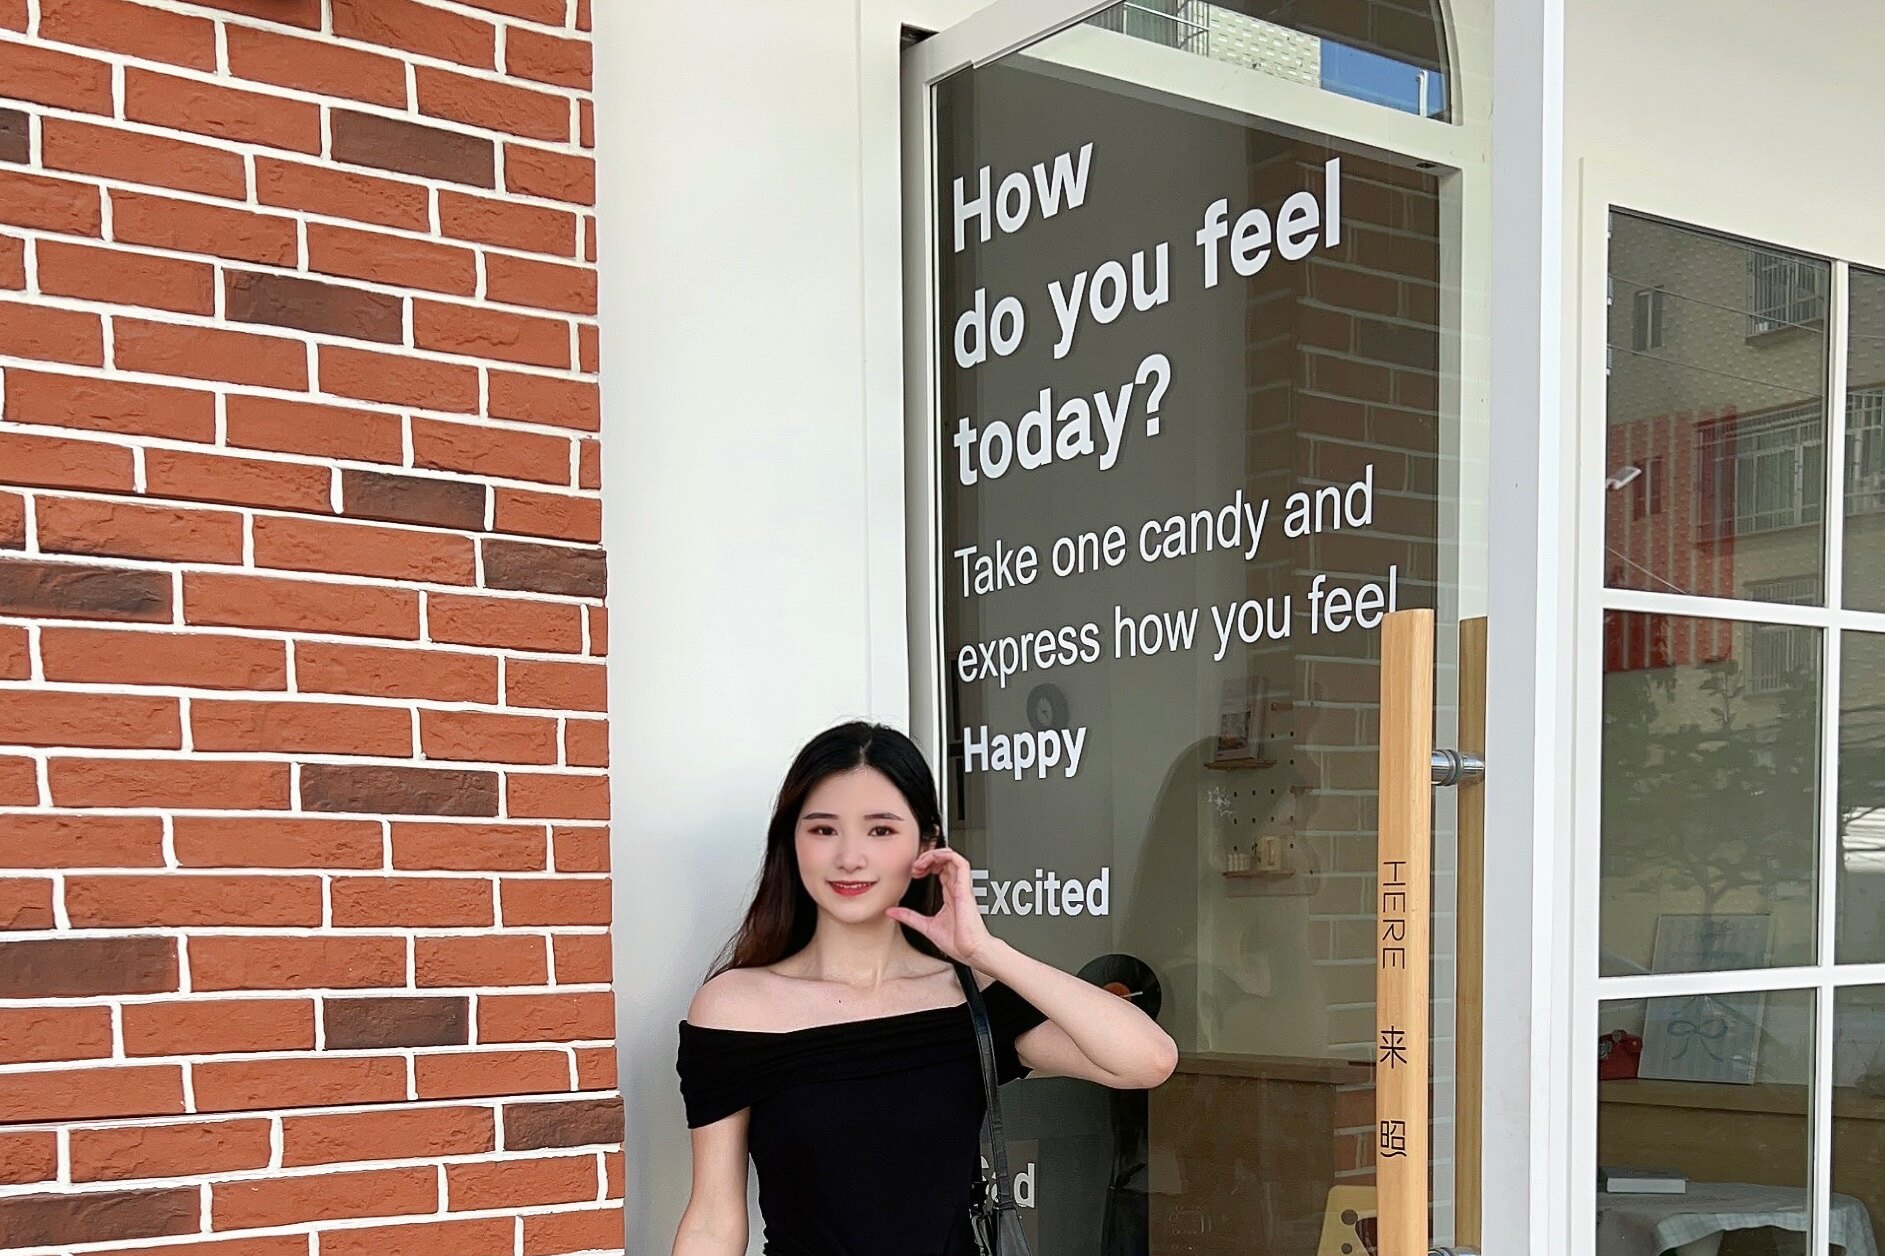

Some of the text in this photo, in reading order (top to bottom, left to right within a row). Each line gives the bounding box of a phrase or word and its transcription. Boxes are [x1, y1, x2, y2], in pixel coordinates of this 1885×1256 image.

[953, 142, 1093, 253] How
[954, 157, 1341, 368] do you feel
[953, 353, 1171, 486] today?
[954, 464, 1373, 598] Take one candy and
[957, 564, 1398, 689] express how you feel
[963, 725, 1087, 781] Happy
[970, 866, 1110, 917] Excited
[1382, 861, 1407, 970] HERE
